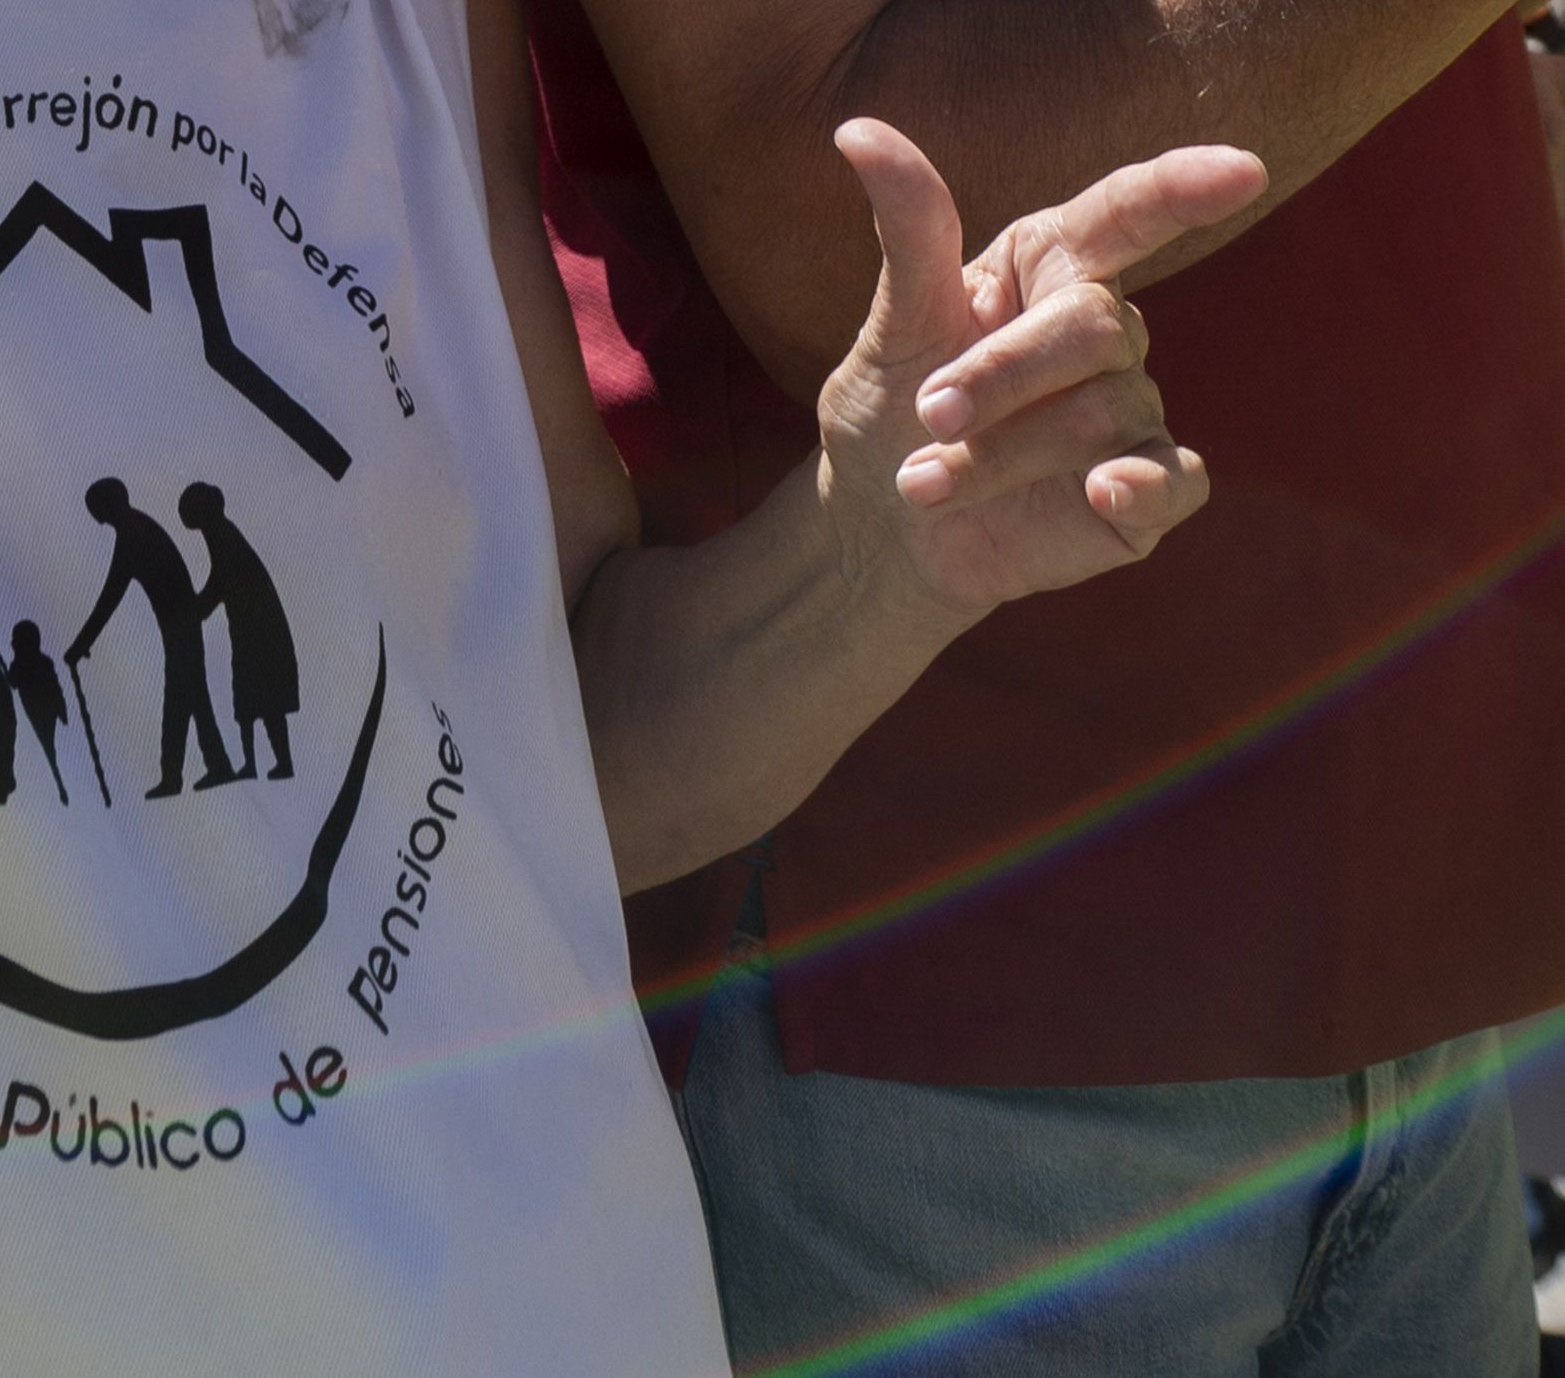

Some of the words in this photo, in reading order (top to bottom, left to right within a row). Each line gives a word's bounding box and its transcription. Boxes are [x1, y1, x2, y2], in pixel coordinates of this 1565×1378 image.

[170, 110, 235, 168] por
[240, 151, 269, 207] la
[271, 195, 417, 420] Defensa
[272, 1042, 348, 1127] de
